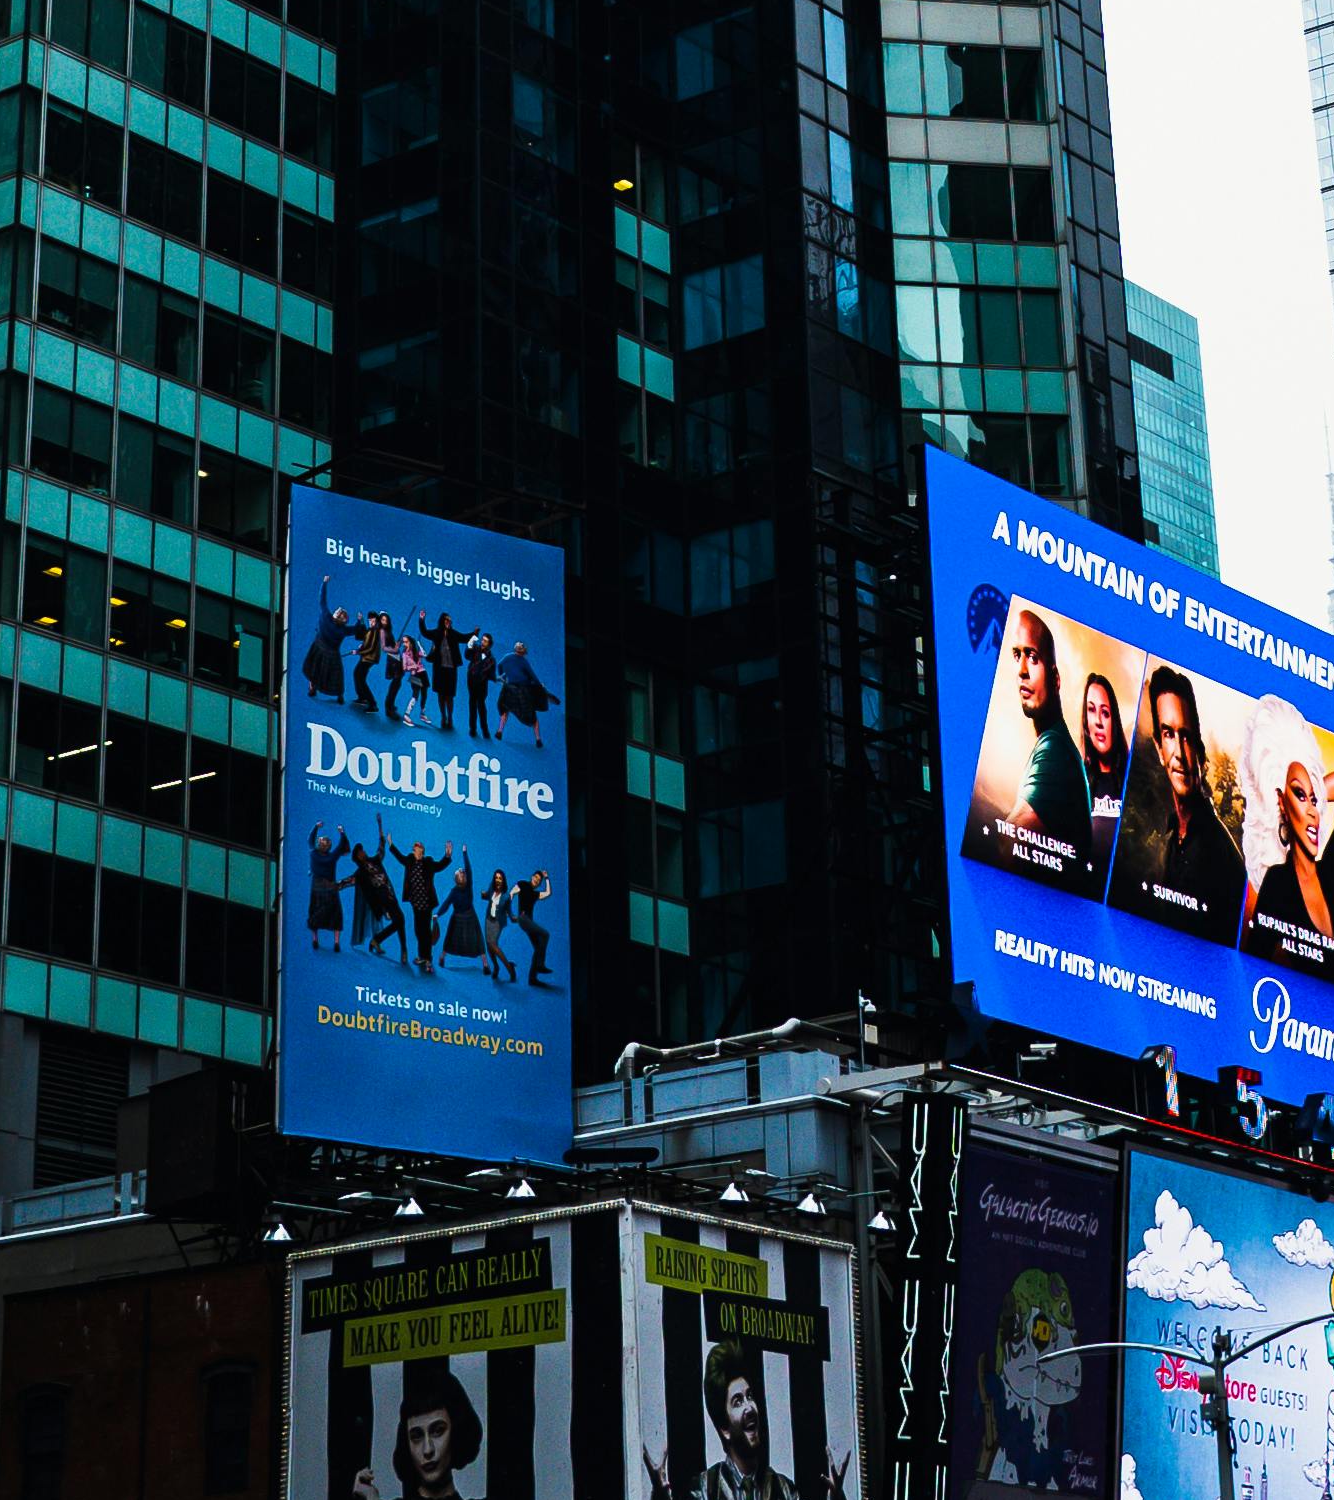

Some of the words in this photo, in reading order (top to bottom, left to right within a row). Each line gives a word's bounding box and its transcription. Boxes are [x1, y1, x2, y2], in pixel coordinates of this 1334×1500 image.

[326, 536, 355, 564] Big
[359, 544, 412, 576] heart,
[417, 558, 471, 587] bigger
[475, 572, 536, 602] laughs.
[991, 511, 1011, 547] A
[1016, 519, 1146, 606] MOUNTAIN
[1147, 581, 1180, 620] OF
[305, 722, 555, 820] Doubtfire
[306, 779, 327, 794] The
[329, 783, 354, 799] New
[355, 788, 397, 807] Musical
[399, 798, 443, 818] Comedy
[995, 818, 1016, 840] THE
[1012, 842, 1030, 862] ALL
[1031, 848, 1063, 873] STARS
[1152, 883, 1199, 912] SURVIVOR
[1257, 912, 1297, 939] RUPAUL'S
[1296, 925, 1322, 948] DRAG
[1281, 937, 1298, 954] ALL
[1298, 942, 1324, 964] STARS
[994, 929, 1058, 970] REALITY
[1060, 951, 1096, 981] HITS
[1098, 961, 1136, 993] NOW
[1137, 975, 1218, 1020] STREAMING
[354, 985, 411, 1009] Tickets
[415, 997, 434, 1013] on
[438, 1001, 468, 1018] sale
[472, 1007, 508, 1025] now!
[317, 1004, 544, 1057] DoubtfireBroadway.com
[308, 1281, 358, 1319] TIMES
[363, 1268, 429, 1311] SQUARE
[435, 1260, 469, 1296] CAN
[476, 1247, 543, 1289] REALLY
[655, 1245, 707, 1285] RAISING
[710, 1257, 759, 1295] SPIRITS
[350, 1321, 400, 1357] MAKE
[406, 1315, 442, 1349] YOU
[449, 1309, 494, 1343] FEEL
[500, 1298, 560, 1337] ALIVE!
[719, 1301, 737, 1334] ON
[741, 1305, 817, 1345] BROADWAY!
[1262, 1341, 1308, 1371] BACK
[1260, 1387, 1309, 1412] GUESTS!
